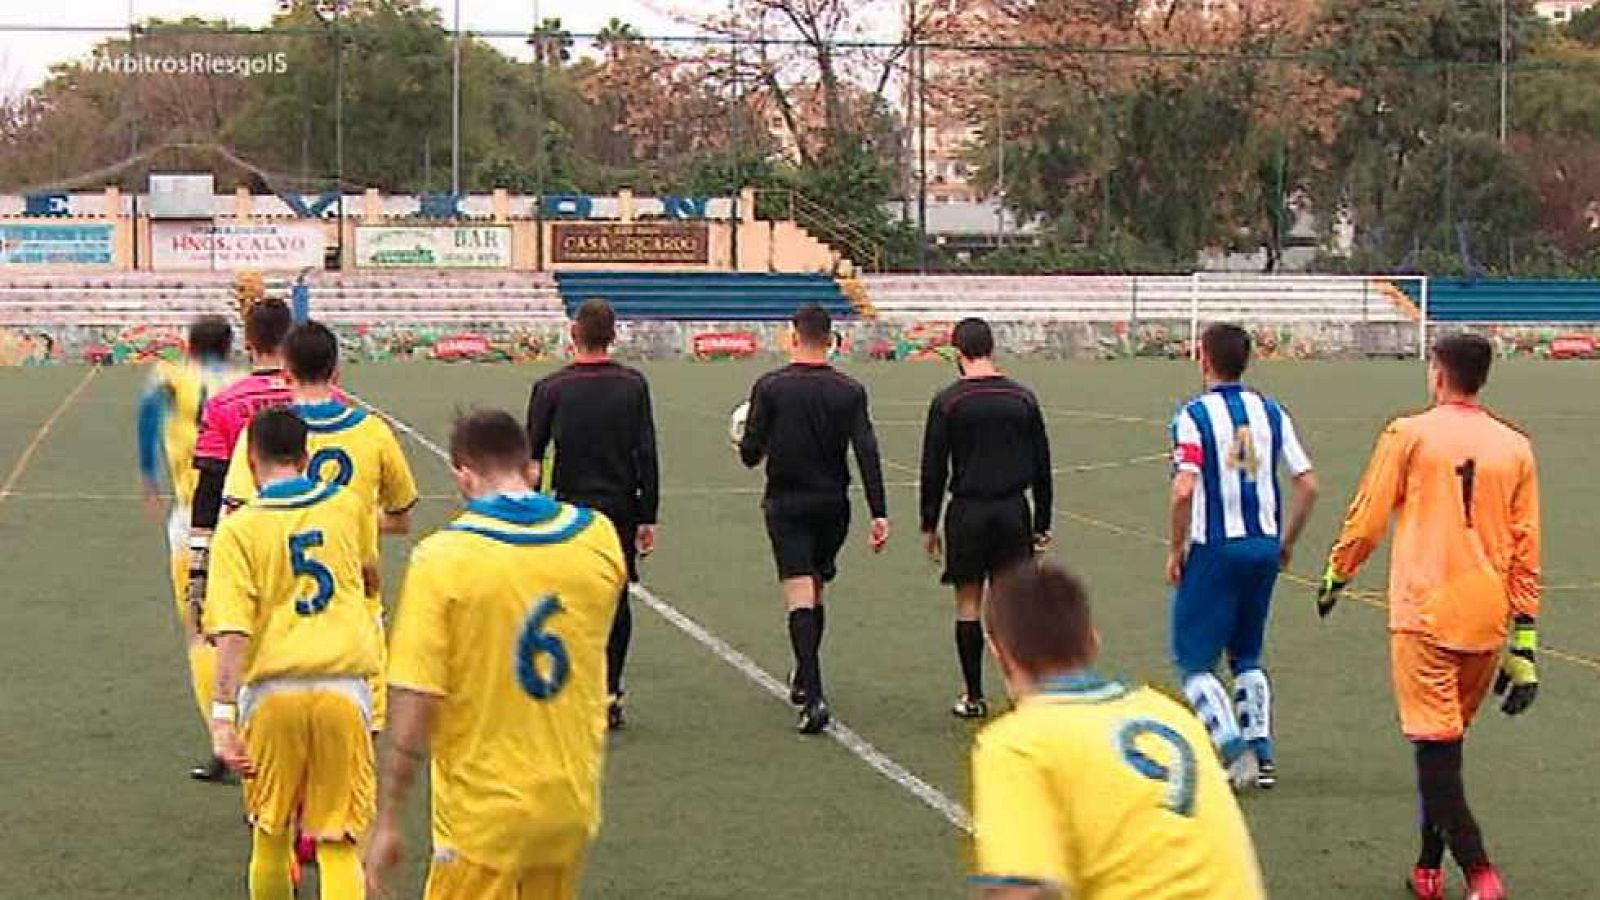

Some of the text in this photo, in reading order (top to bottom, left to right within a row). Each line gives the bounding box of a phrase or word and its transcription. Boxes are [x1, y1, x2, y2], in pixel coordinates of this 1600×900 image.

[236, 236, 306, 251] CALVO
[454, 230, 499, 248] BAR
[563, 235, 610, 251] CASA
[1225, 426, 1261, 479] 4
[1455, 458, 1477, 528] 1
[288, 530, 335, 615] 5
[515, 594, 571, 700] 6
[1117, 719, 1196, 817] 9
